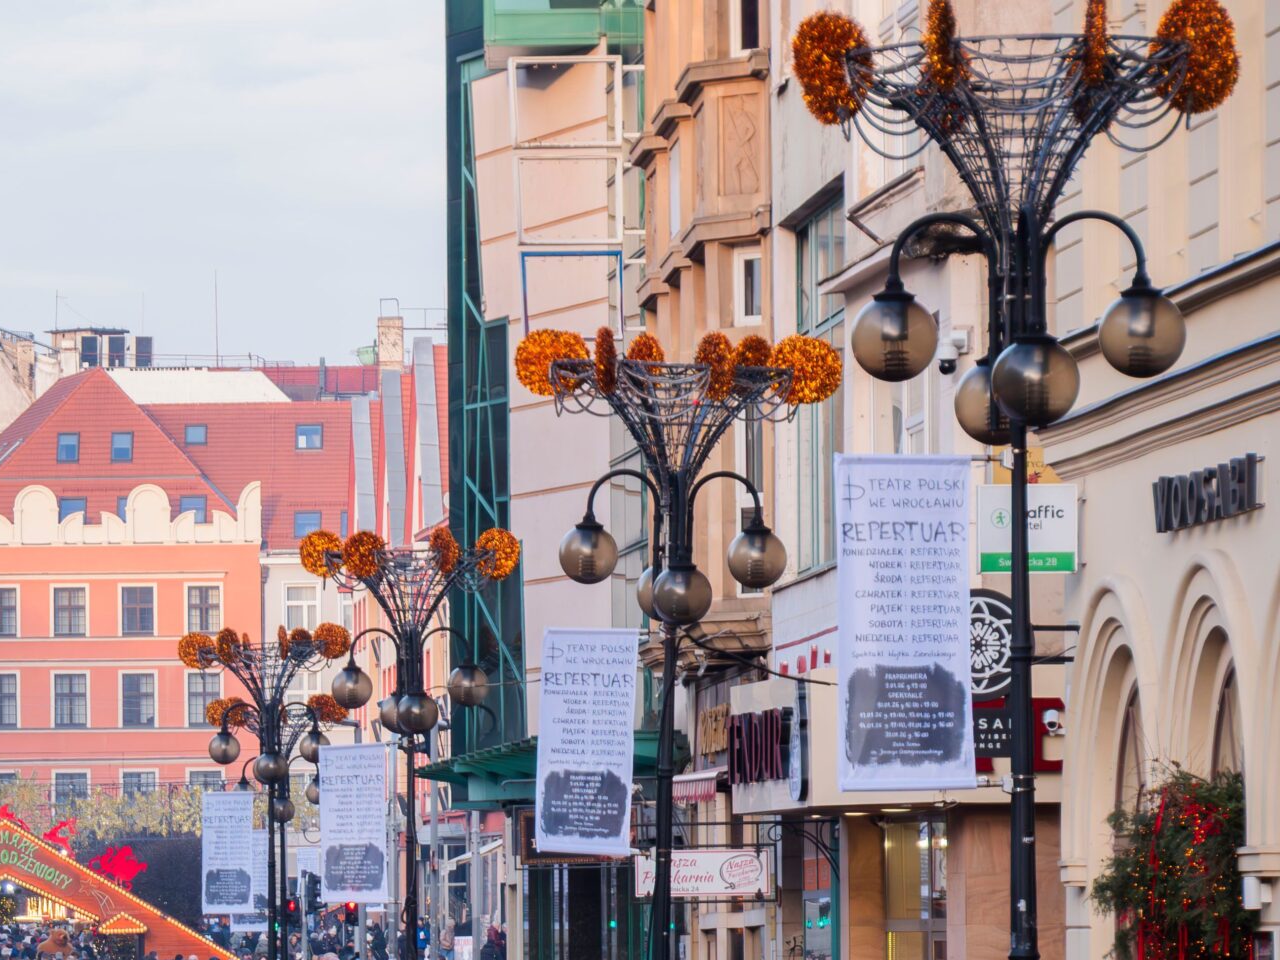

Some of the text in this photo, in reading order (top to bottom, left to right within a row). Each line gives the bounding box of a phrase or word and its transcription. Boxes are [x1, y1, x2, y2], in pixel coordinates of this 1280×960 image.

[870, 478, 965, 490] TEATR POLSKI
[870, 497, 964, 509] WE WROCŁAWIU
[1027, 505, 1064, 518] affic
[842, 521, 967, 543] REPERTUAR
[567, 644, 634, 654] TEATR POLSKI
[544, 672, 634, 688] REPERTUAR
[321, 774, 384, 786] REPERTUAR
[671, 858, 697, 868] asza
